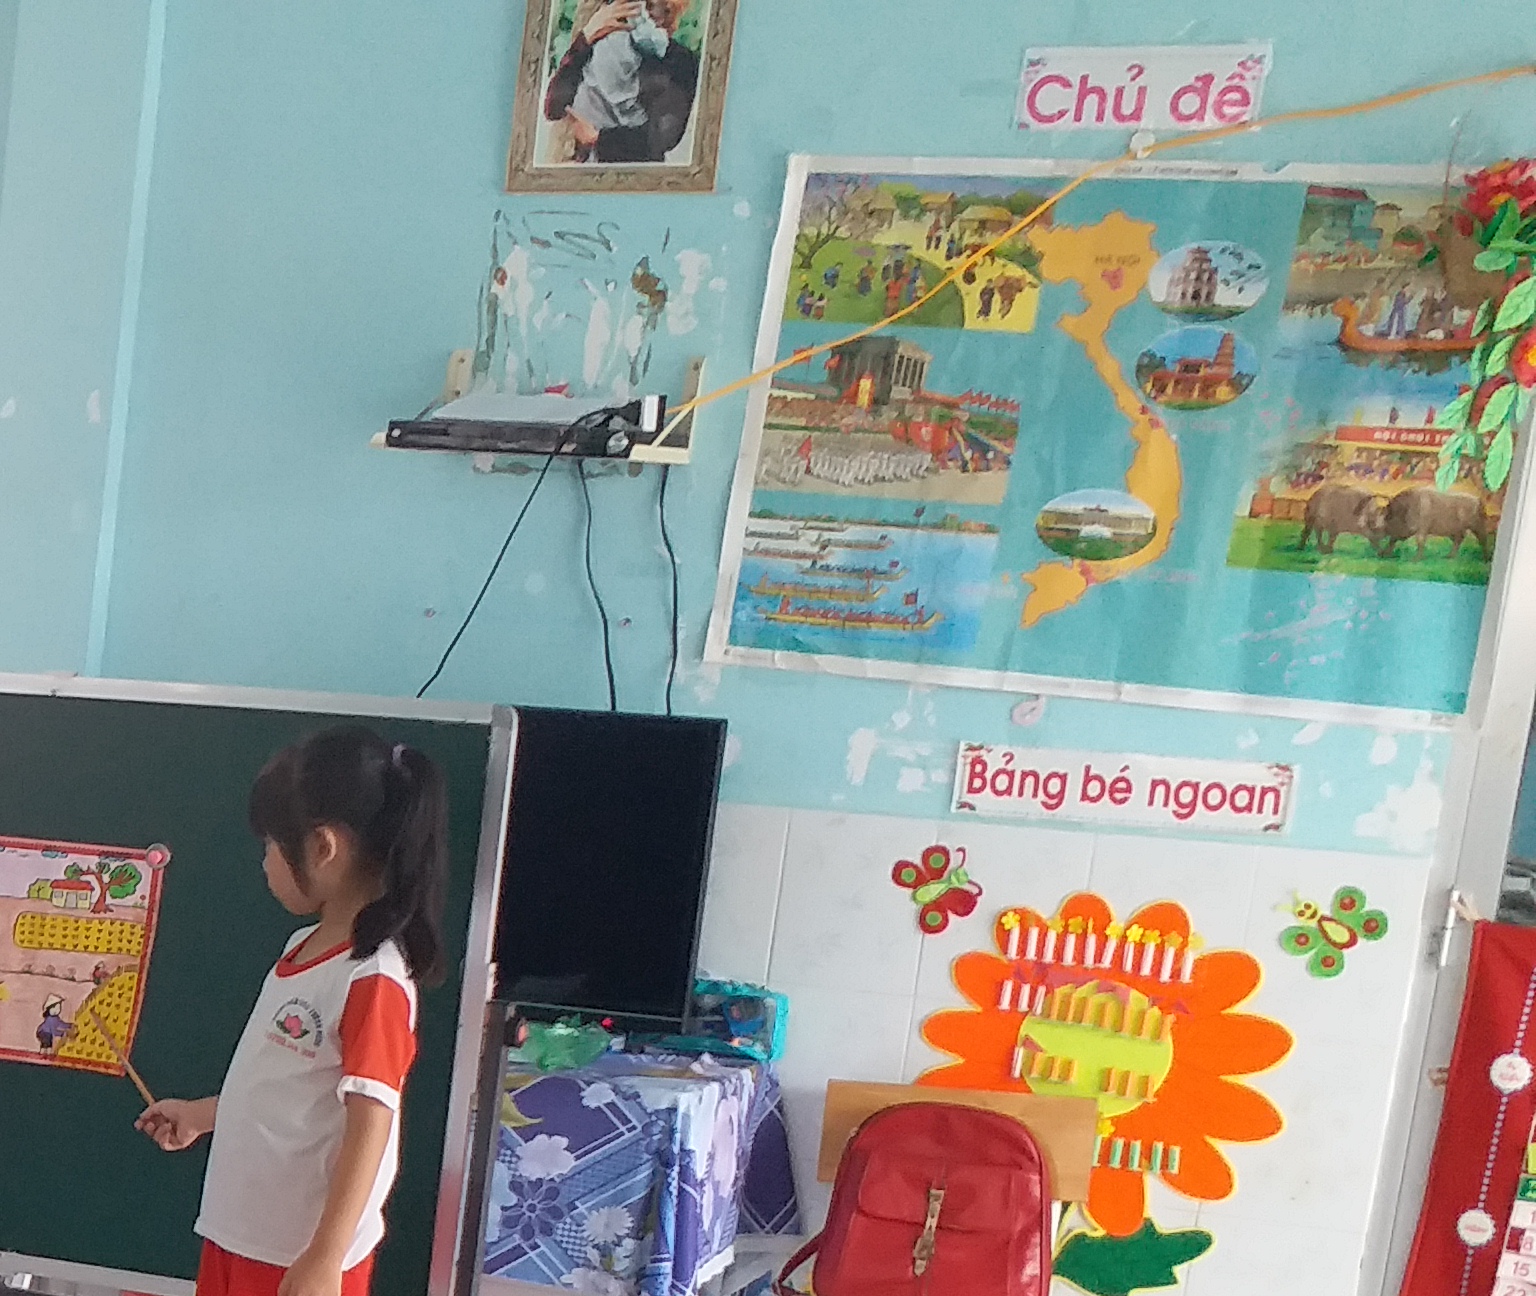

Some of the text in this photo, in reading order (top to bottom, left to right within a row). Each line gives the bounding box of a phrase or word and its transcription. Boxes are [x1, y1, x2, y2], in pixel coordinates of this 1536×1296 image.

[1026, 63, 1148, 124] Chủ
[965, 752, 1282, 821] Bảng bé ngoan
[1513, 1261, 1530, 1277] 15
